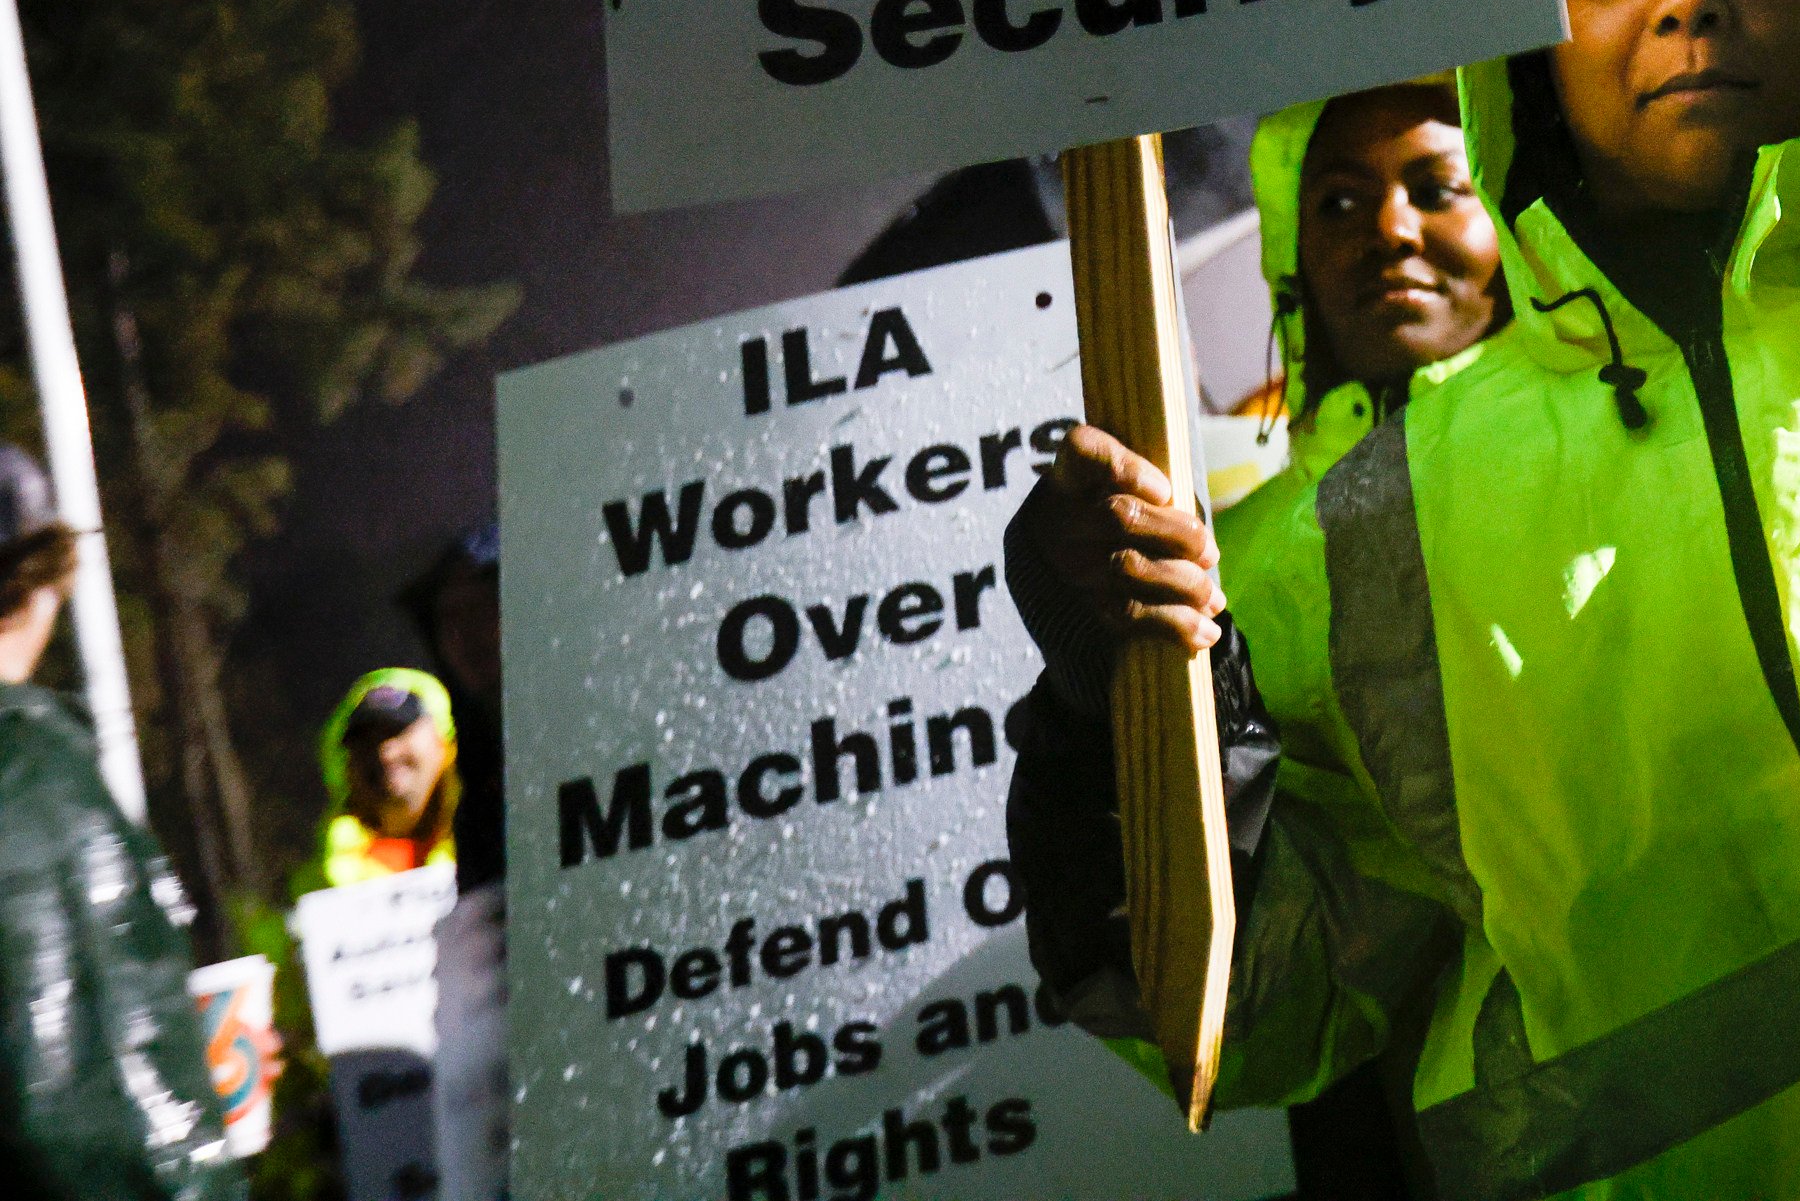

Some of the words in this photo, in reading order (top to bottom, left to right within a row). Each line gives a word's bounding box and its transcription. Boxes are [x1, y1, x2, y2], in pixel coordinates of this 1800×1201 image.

[739, 307, 933, 419] ILA
[714, 564, 997, 687] Over
[554, 694, 1024, 873] Machin
[604, 878, 930, 1020] Defend
[656, 1019, 884, 1119] Jobs
[725, 1094, 1038, 1201] Rights
